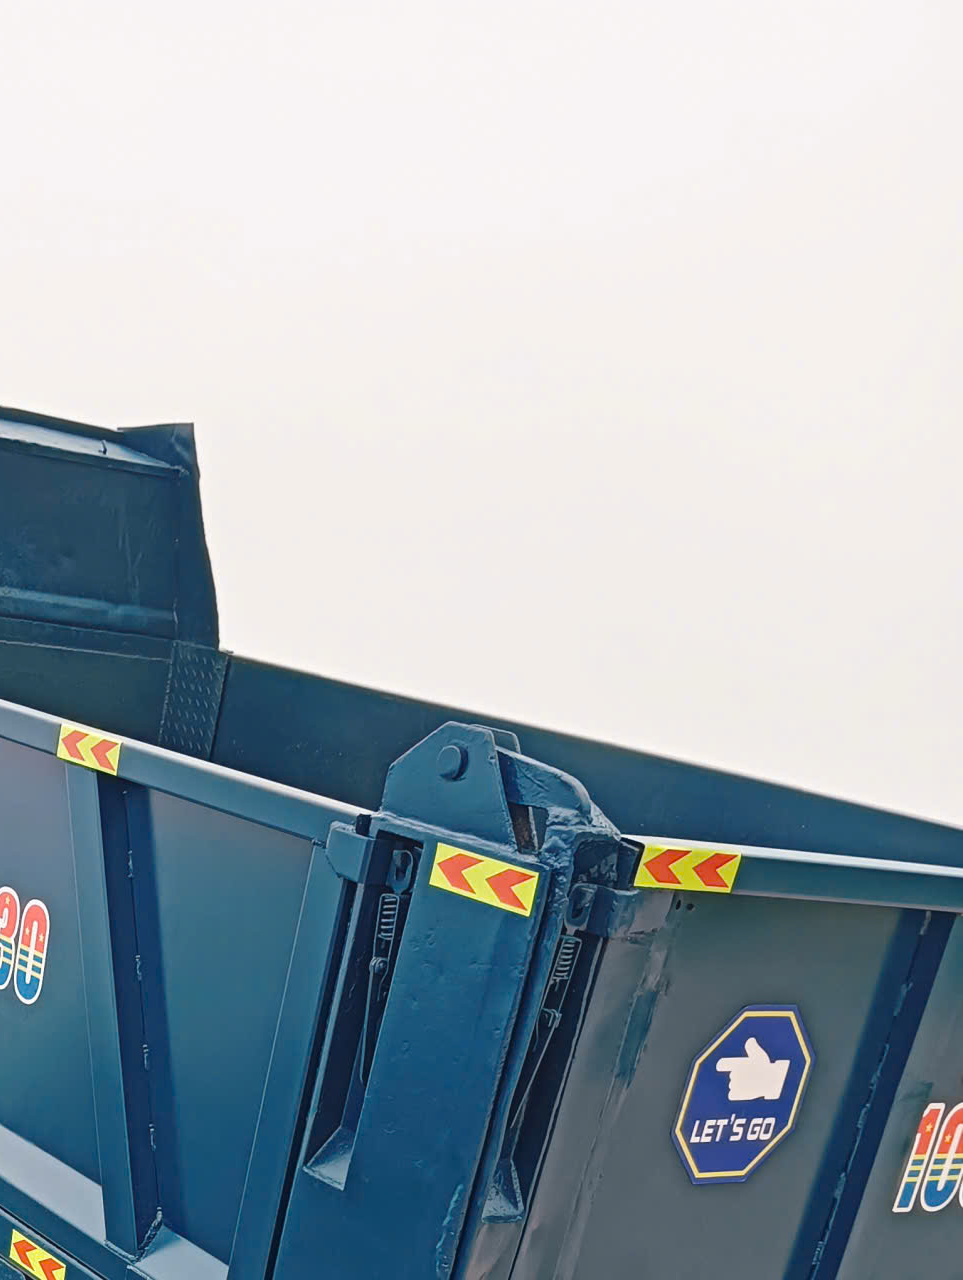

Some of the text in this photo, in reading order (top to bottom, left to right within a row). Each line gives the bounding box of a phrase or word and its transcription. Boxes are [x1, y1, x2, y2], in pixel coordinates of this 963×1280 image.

[690, 1113, 776, 1143] LET'S GO
[892, 1102, 963, 1213] 10
